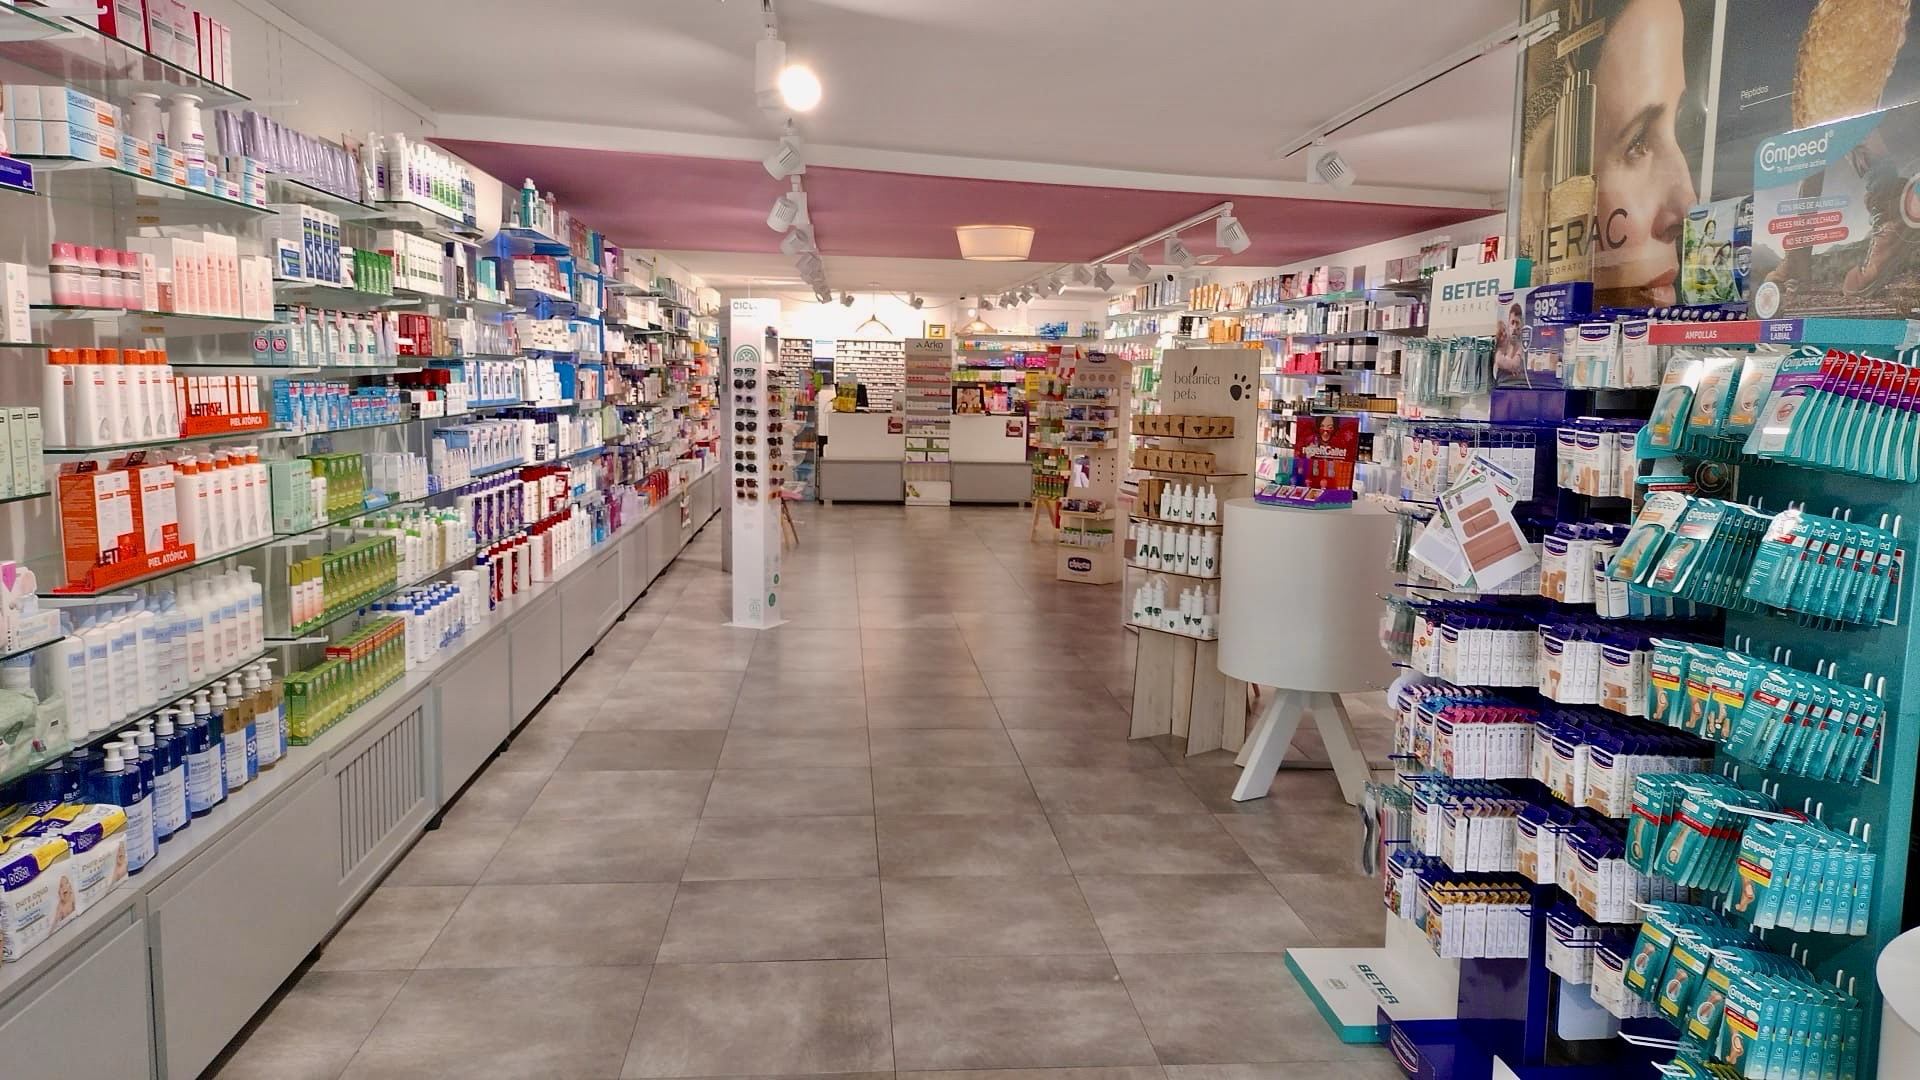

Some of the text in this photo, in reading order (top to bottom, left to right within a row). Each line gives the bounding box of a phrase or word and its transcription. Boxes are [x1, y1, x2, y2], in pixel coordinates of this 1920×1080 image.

[1531, 207, 1628, 267] IERAC
[1442, 278, 1500, 301] BETER
[1534, 297, 1558, 317] 99%
[1685, 330, 1718, 340] AMPOLLAS
[1770, 323, 1793, 332] HERPES
[1770, 332, 1791, 341] LABIAL
[1173, 388, 1198, 403] pets
[147, 549, 189, 568] PIEL ATÓPICA
[1357, 963, 1400, 1005] BETER
